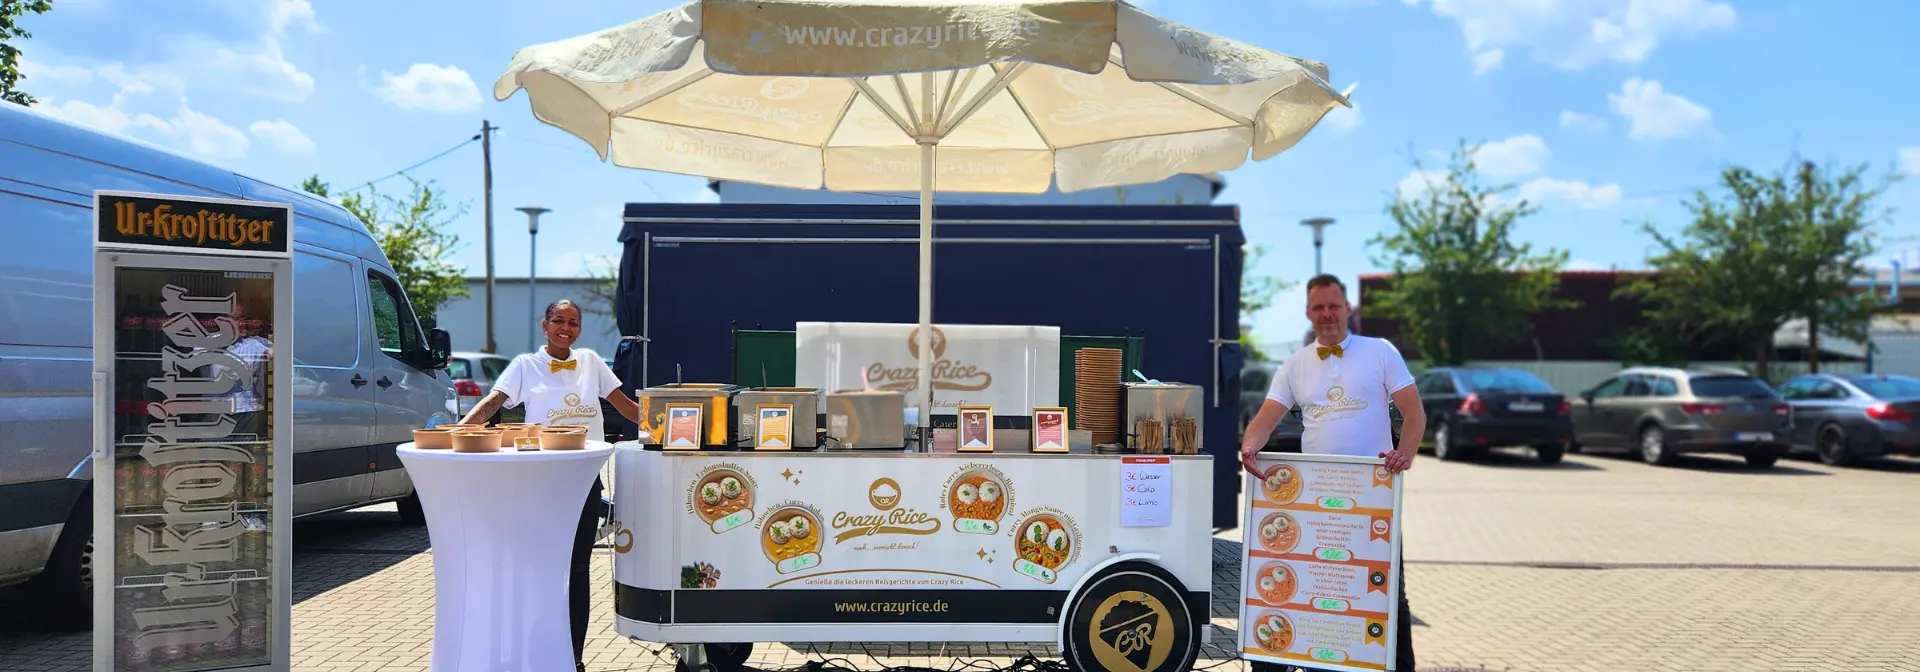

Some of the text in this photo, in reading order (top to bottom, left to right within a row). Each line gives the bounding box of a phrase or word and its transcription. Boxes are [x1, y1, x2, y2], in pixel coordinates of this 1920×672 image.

[783, 16, 1040, 50] www.crazyricde
[931, 359, 979, 379] Rice
[547, 404, 595, 419] Crazy Rice
[933, 418, 957, 428] Cater
[1137, 484, 1156, 493] Cola
[1138, 498, 1159, 506] Limo
[1324, 498, 1344, 508] 12€
[831, 507, 928, 536] Crazy Rice
[1007, 518, 1023, 538] Curry
[1020, 506, 1044, 518] Mango
[1044, 505, 1065, 515] Sauce
[805, 578, 833, 586] Genieße
[833, 578, 844, 586] die
[845, 578, 874, 586] leckeren
[875, 578, 916, 587] Reisgerichte
[931, 579, 949, 587] Crazy
[834, 600, 949, 616] www.crazyrice.de
